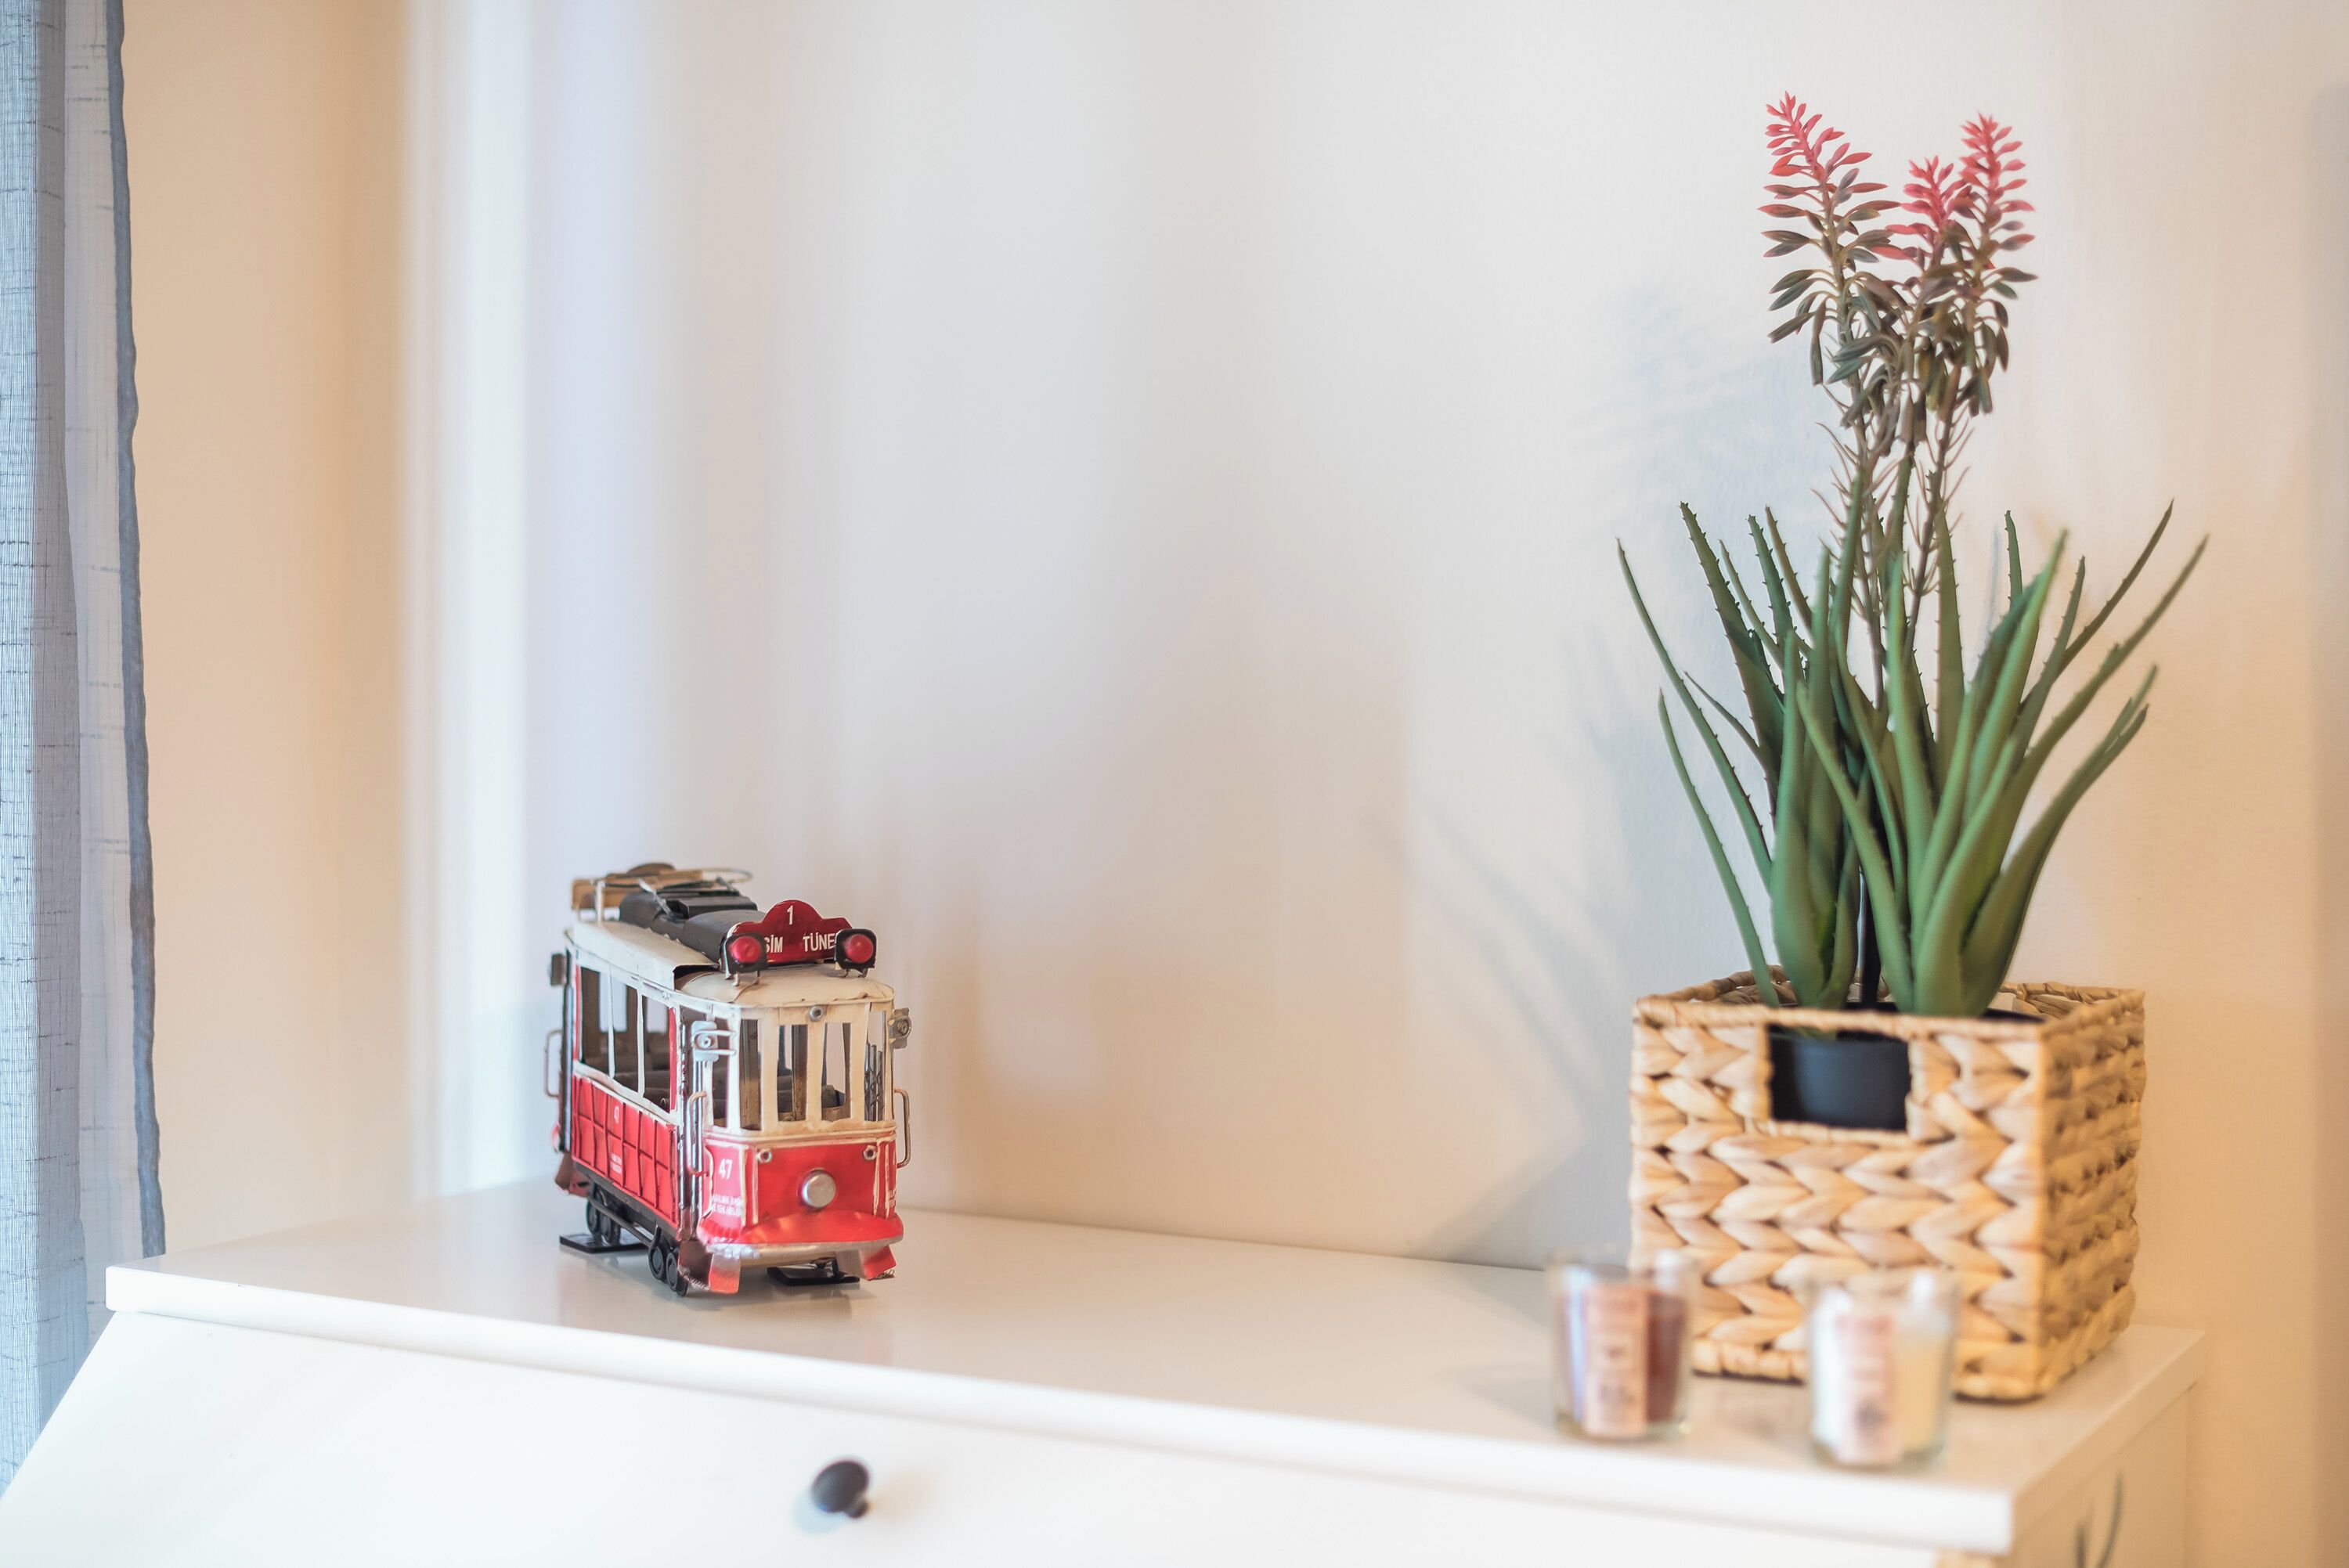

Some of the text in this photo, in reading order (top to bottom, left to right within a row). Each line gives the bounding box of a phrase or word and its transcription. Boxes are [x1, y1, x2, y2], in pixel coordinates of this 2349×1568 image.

[786, 904, 794, 925] 1
[764, 932, 836, 953] SİM TÜNE
[719, 1159, 733, 1180] 47
